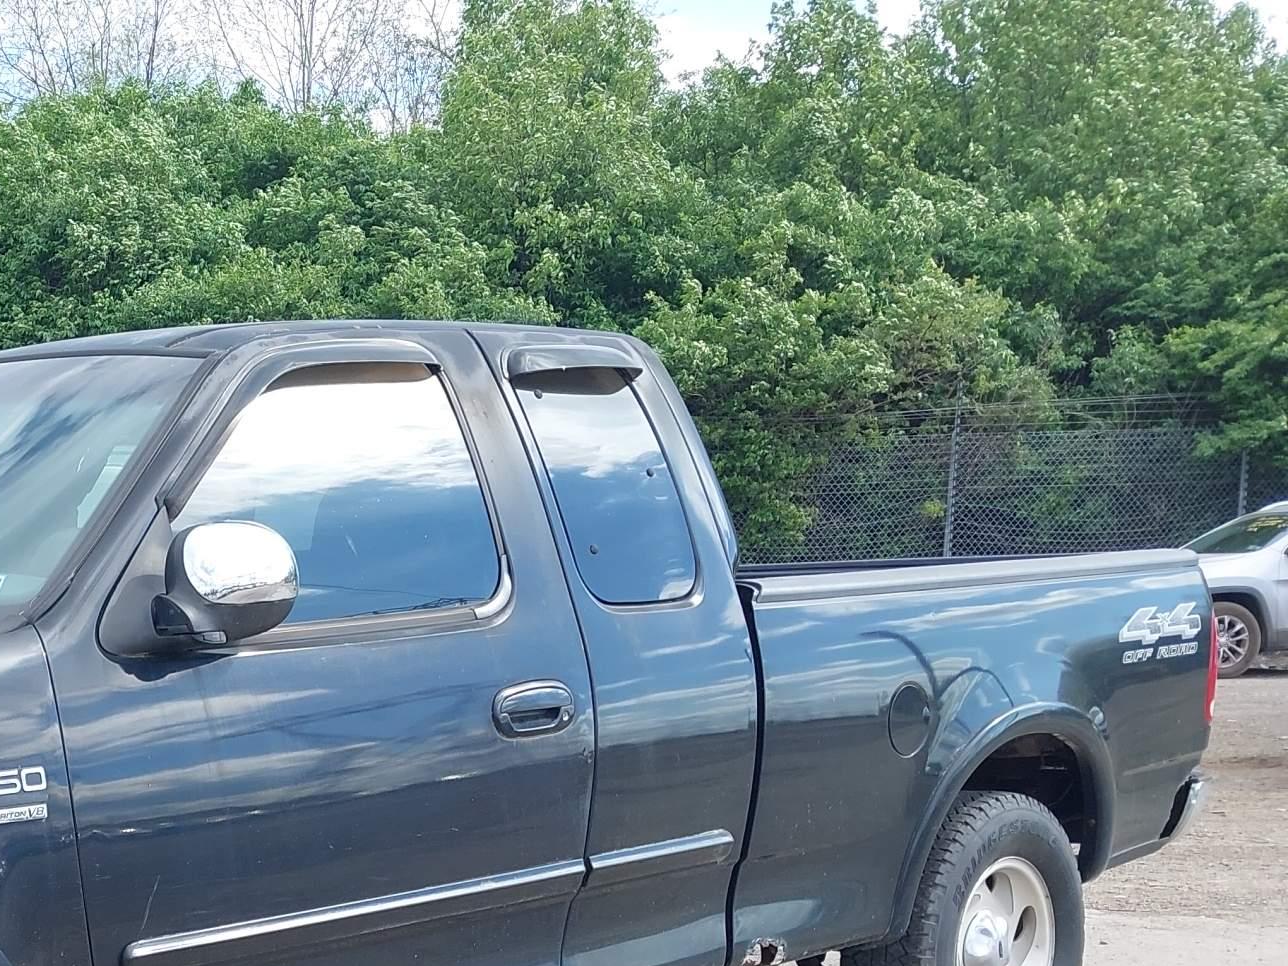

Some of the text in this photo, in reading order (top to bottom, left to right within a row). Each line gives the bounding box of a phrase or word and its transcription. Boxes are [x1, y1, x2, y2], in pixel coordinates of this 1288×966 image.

[1122, 641, 1199, 664] OFF ROAD
[27, 806, 46, 819] V8
